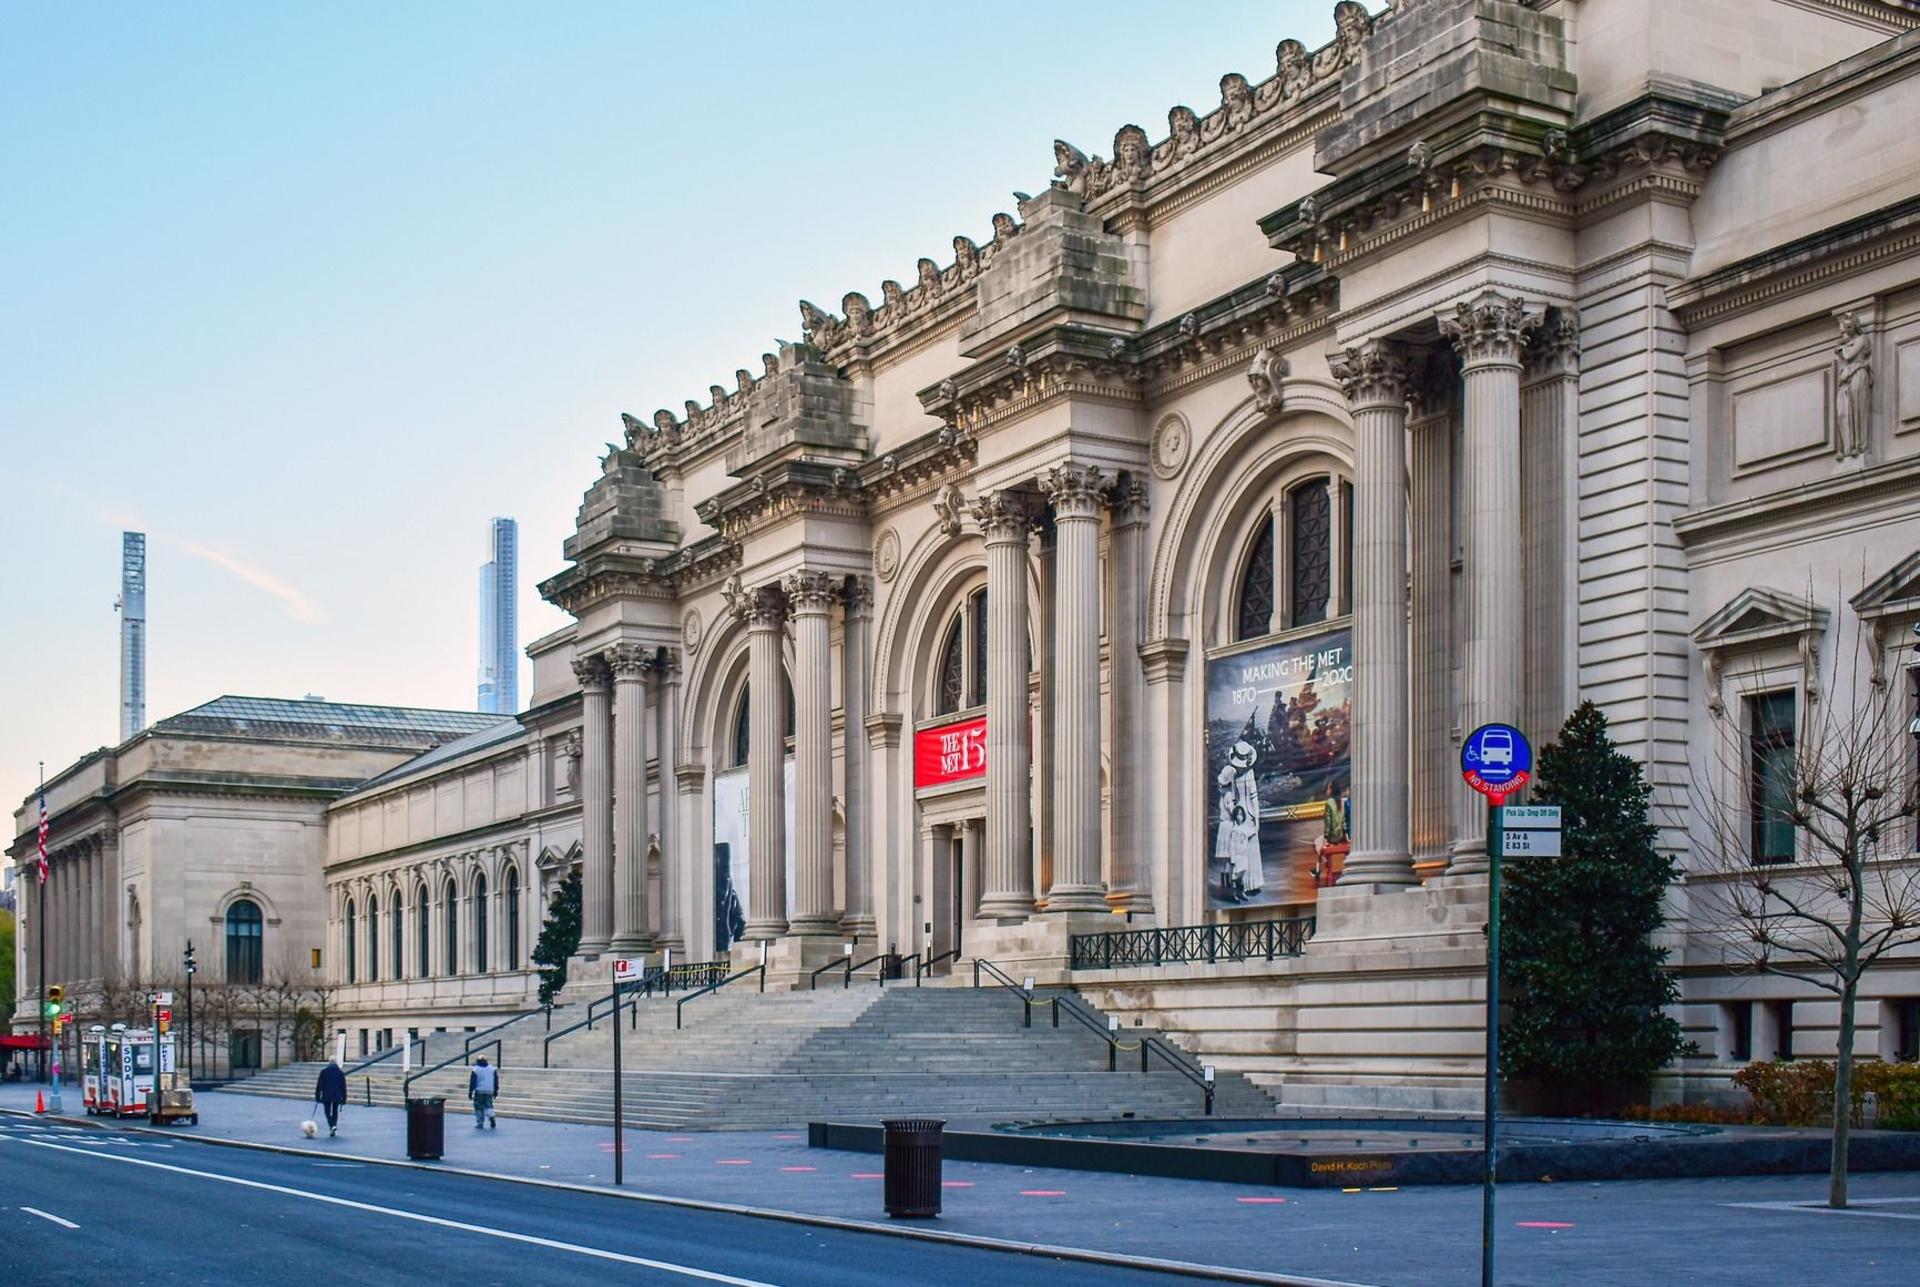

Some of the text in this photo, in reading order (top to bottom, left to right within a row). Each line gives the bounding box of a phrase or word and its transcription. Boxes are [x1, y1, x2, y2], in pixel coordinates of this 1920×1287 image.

[1243, 646, 1343, 684] MAKING THE MET
[1232, 687, 1257, 706] 1870
[940, 732, 961, 754] THE
[961, 727, 988, 771] 15
[940, 753, 961, 776] MET
[1468, 774, 1524, 793] NO STANDING
[1506, 808, 1516, 817] Pick
[1539, 808, 1547, 817] Off
[1548, 808, 1559, 818] Only
[1506, 832, 1529, 841] 5 Av &
[1506, 841, 1531, 850] E 83 St
[123, 1047, 132, 1081] SODA
[1311, 1161, 1336, 1173] David
[1347, 1160, 1368, 1171] Koch
